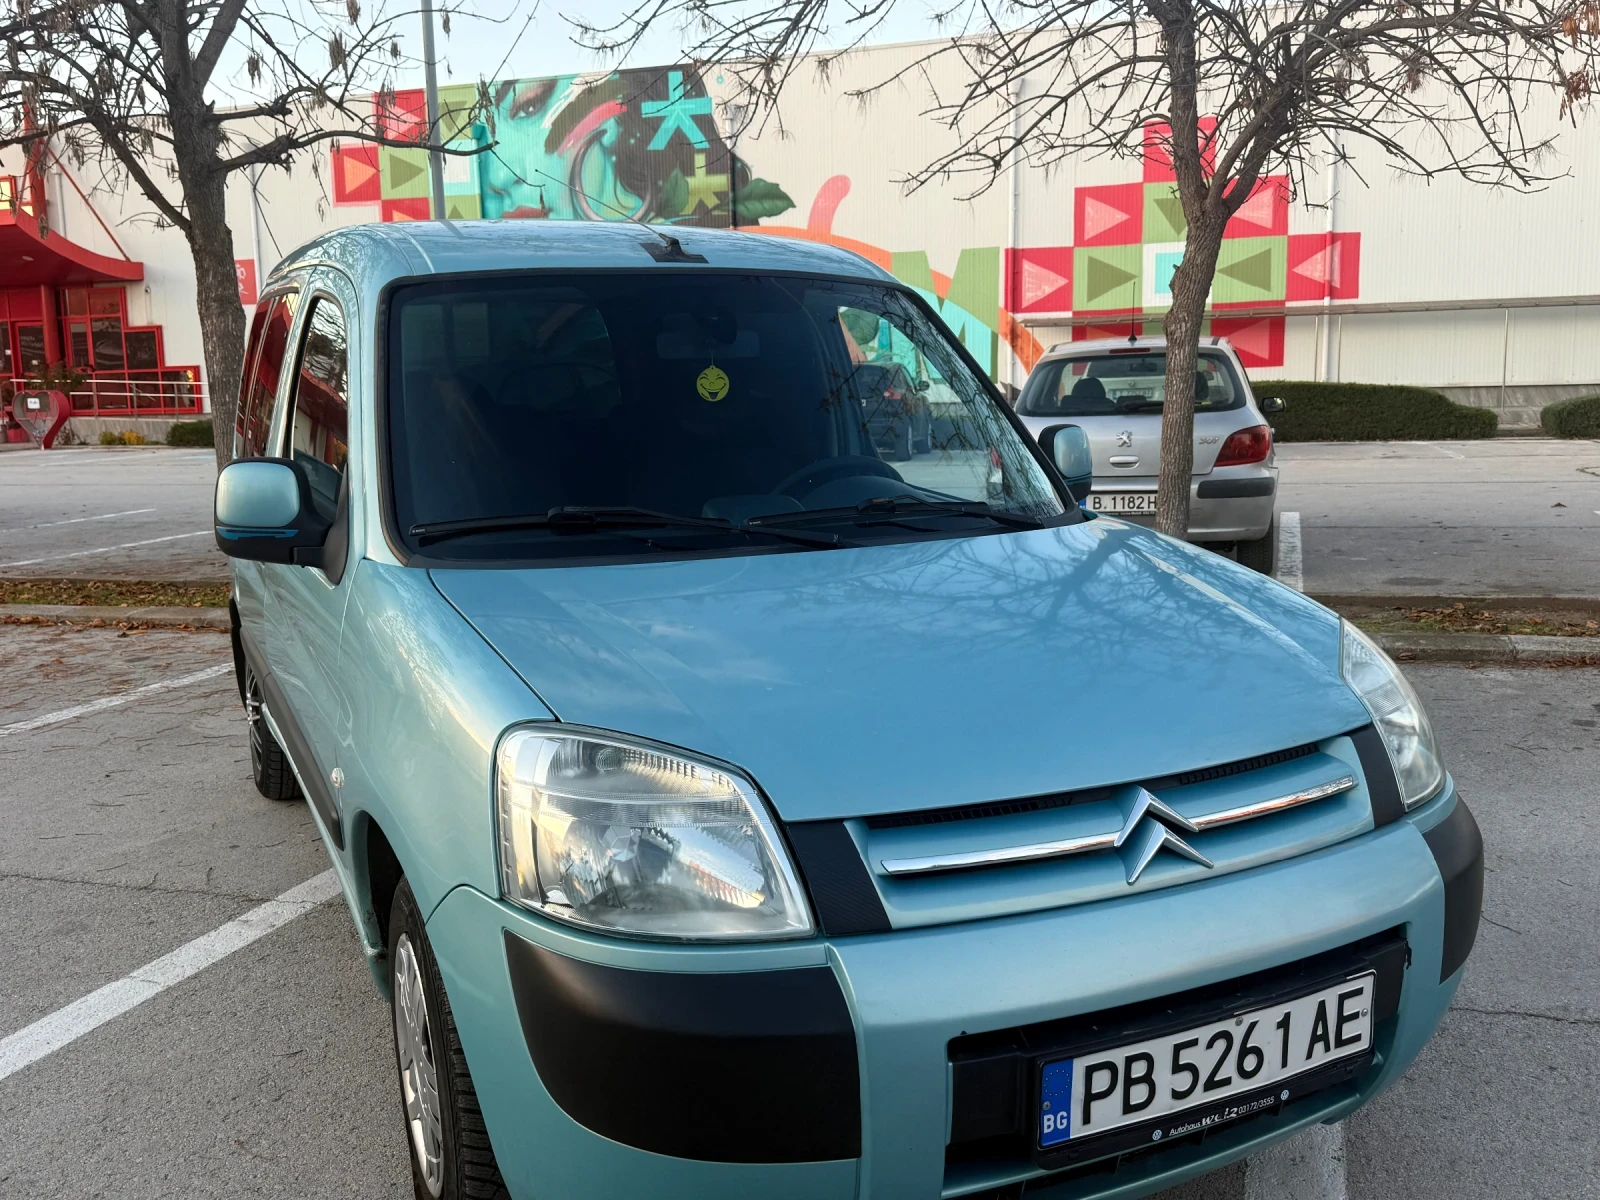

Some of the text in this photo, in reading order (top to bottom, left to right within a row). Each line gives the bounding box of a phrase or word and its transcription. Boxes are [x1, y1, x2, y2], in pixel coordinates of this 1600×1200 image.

[1199, 436, 1219, 445] 307
[1171, 1010, 1292, 1100] 5261
[1043, 1114, 1068, 1134] BG
[1169, 1122, 1201, 1137] Autohaus
